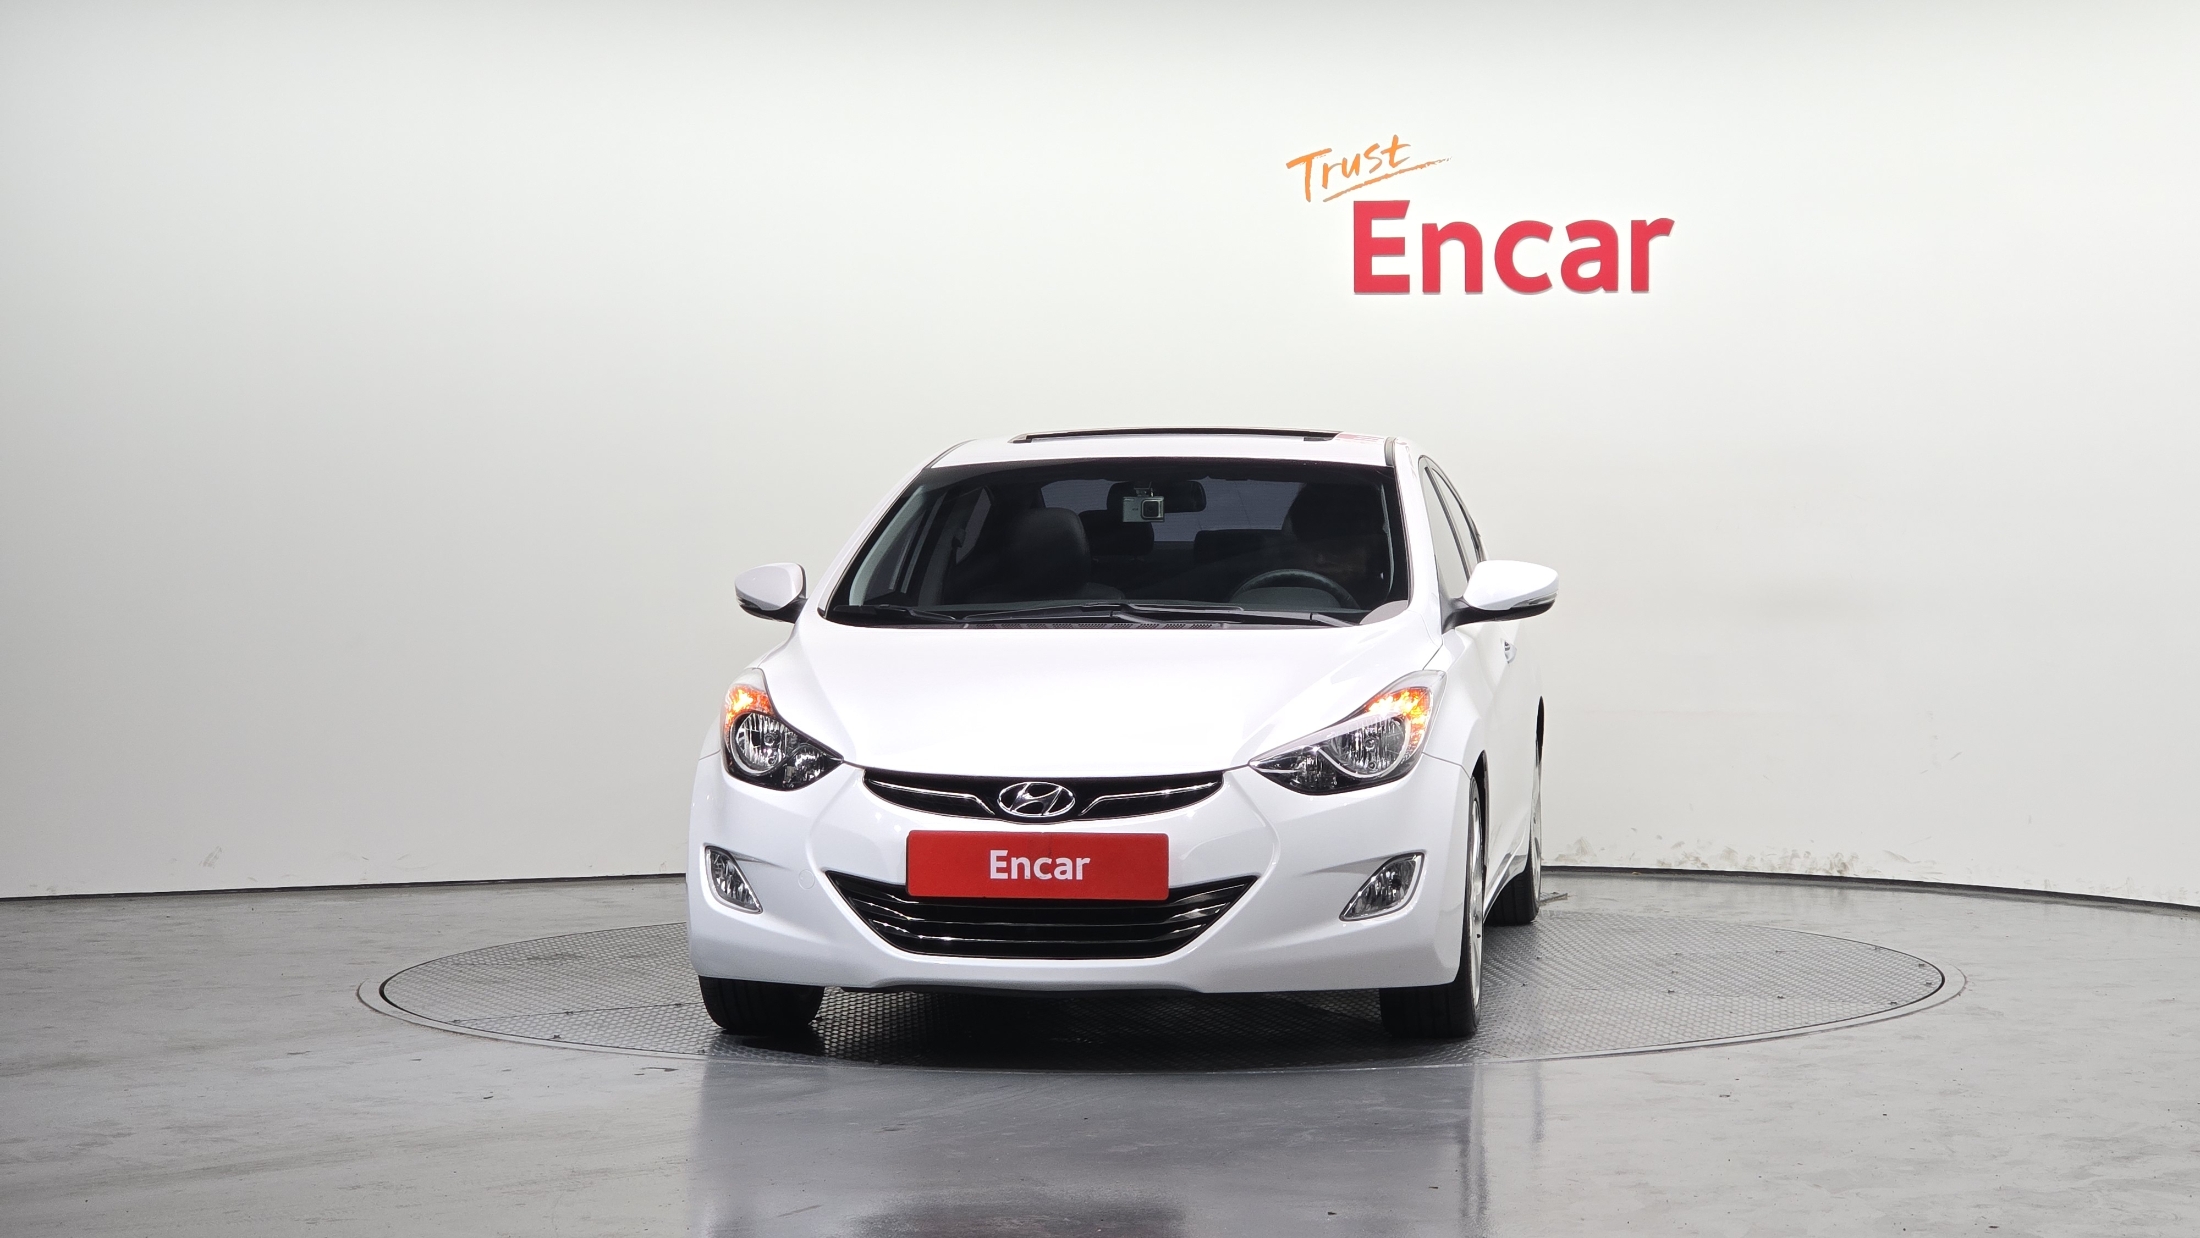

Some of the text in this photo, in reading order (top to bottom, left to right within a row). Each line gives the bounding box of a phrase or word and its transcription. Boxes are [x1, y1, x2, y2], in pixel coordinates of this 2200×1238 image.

[1286, 134, 1412, 202] Trust
[1353, 200, 1675, 294] Encar
[989, 849, 1091, 880] Encar
